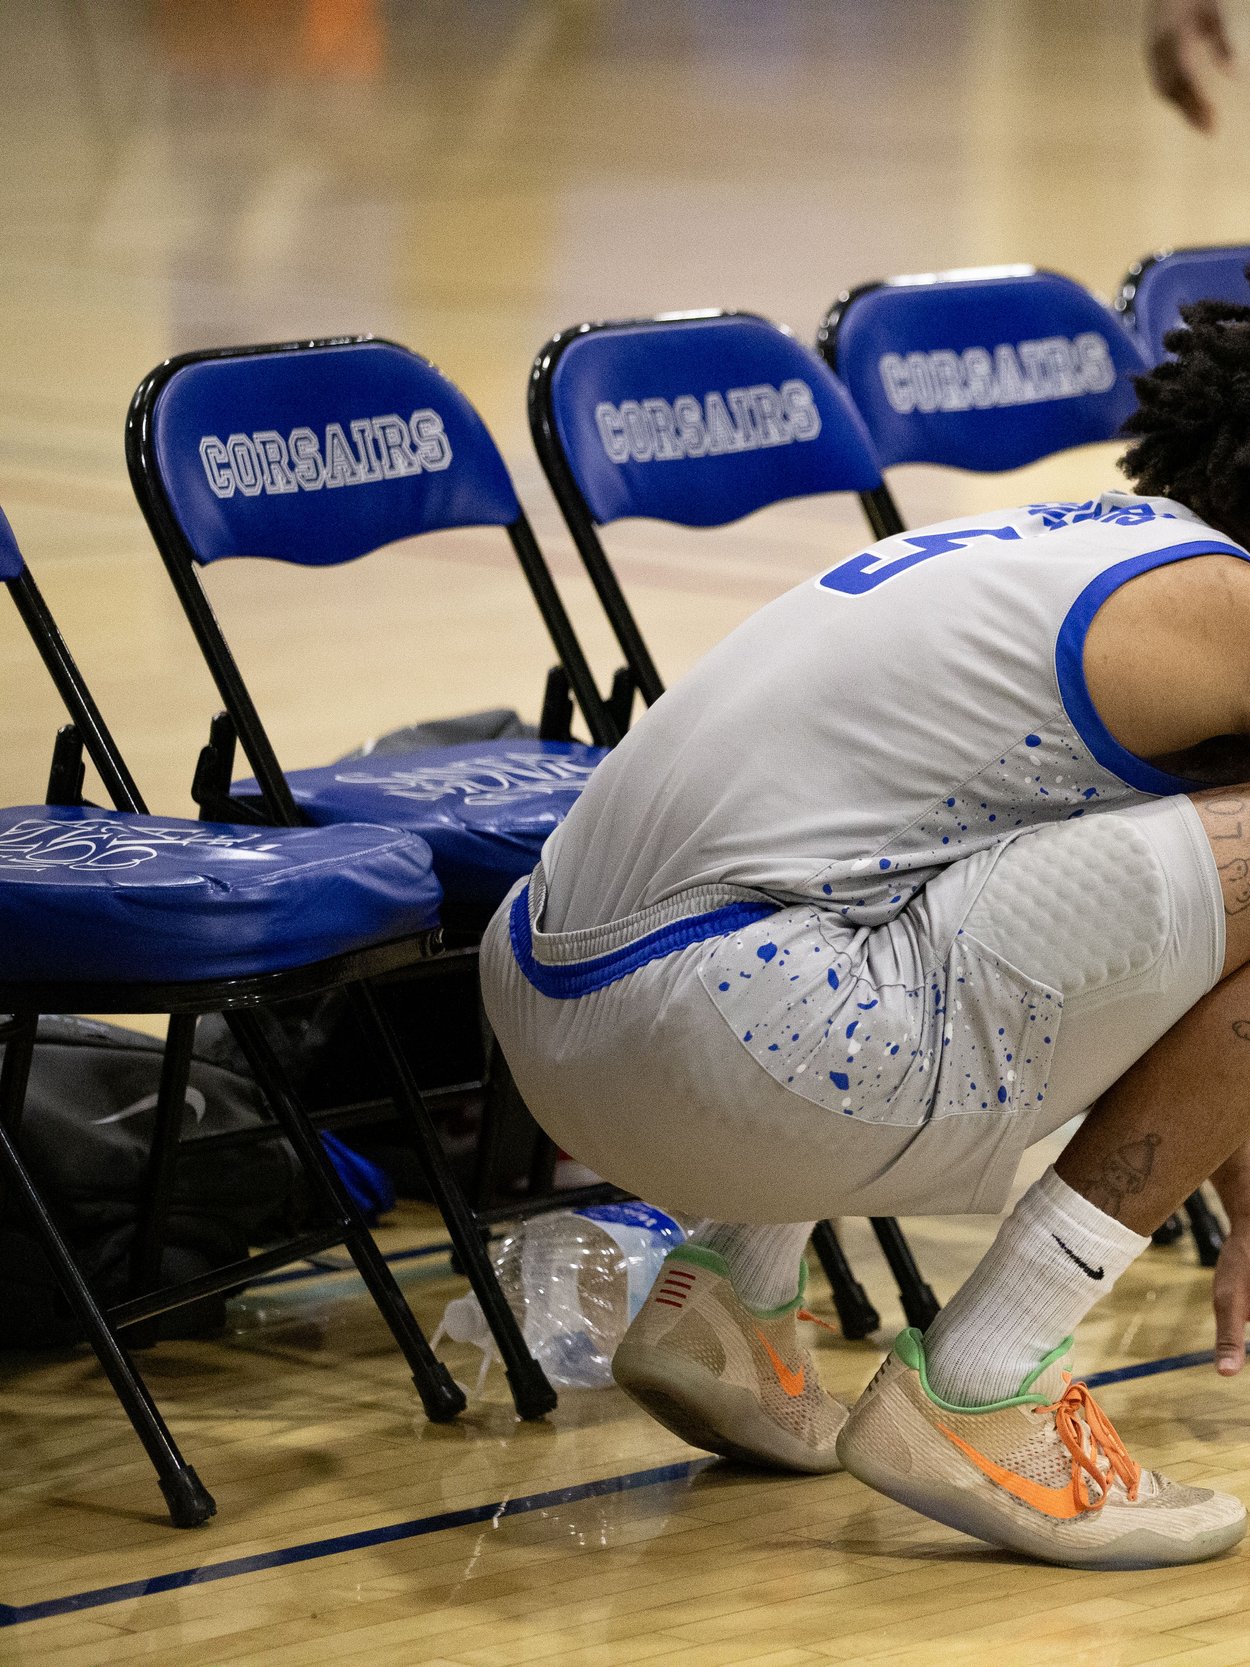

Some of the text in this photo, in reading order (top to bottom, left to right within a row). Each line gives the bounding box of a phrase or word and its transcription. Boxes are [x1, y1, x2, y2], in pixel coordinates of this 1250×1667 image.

[880, 331, 1116, 414] CORSAIRS
[199, 408, 453, 498] CORSAIRS
[594, 379, 823, 463] CORSAIRS
